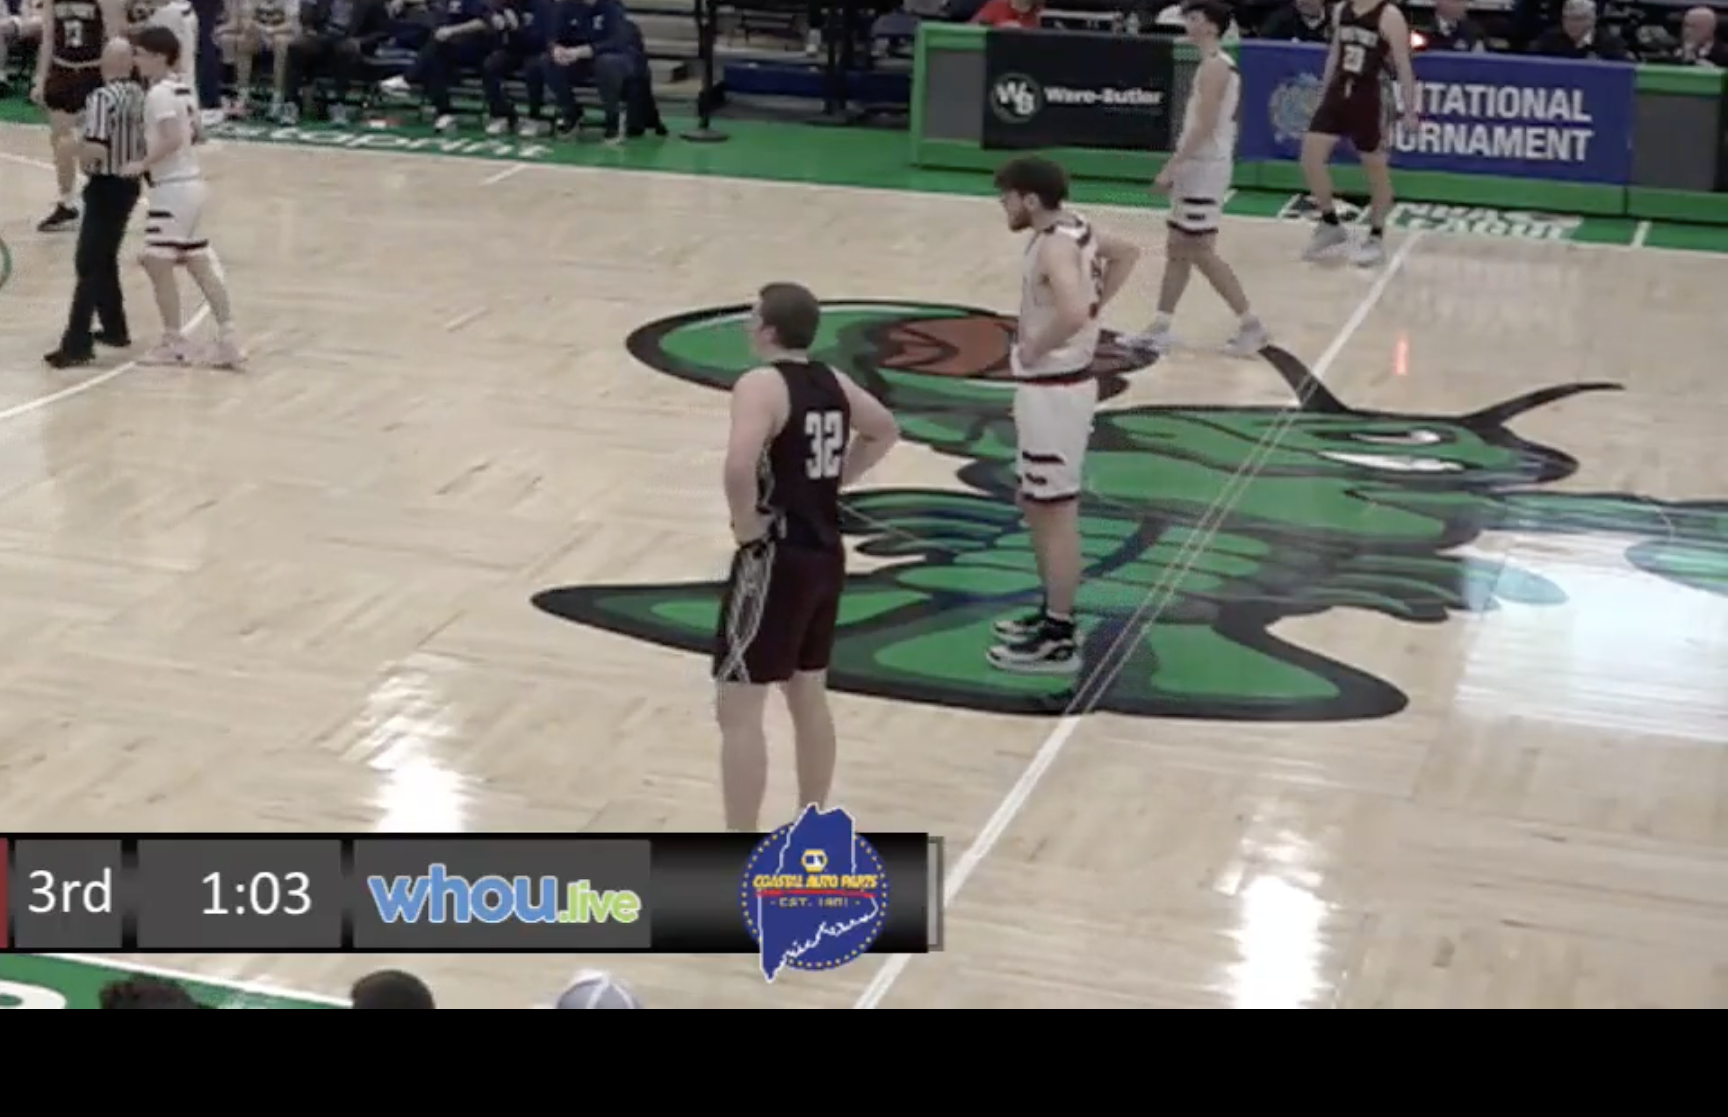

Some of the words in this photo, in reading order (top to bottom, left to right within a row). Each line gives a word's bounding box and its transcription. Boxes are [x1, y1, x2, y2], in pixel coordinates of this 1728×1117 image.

[1043, 86, 1164, 105] Ware-Butler
[1390, 122, 1595, 162] URNAMENT
[805, 411, 844, 479] 32
